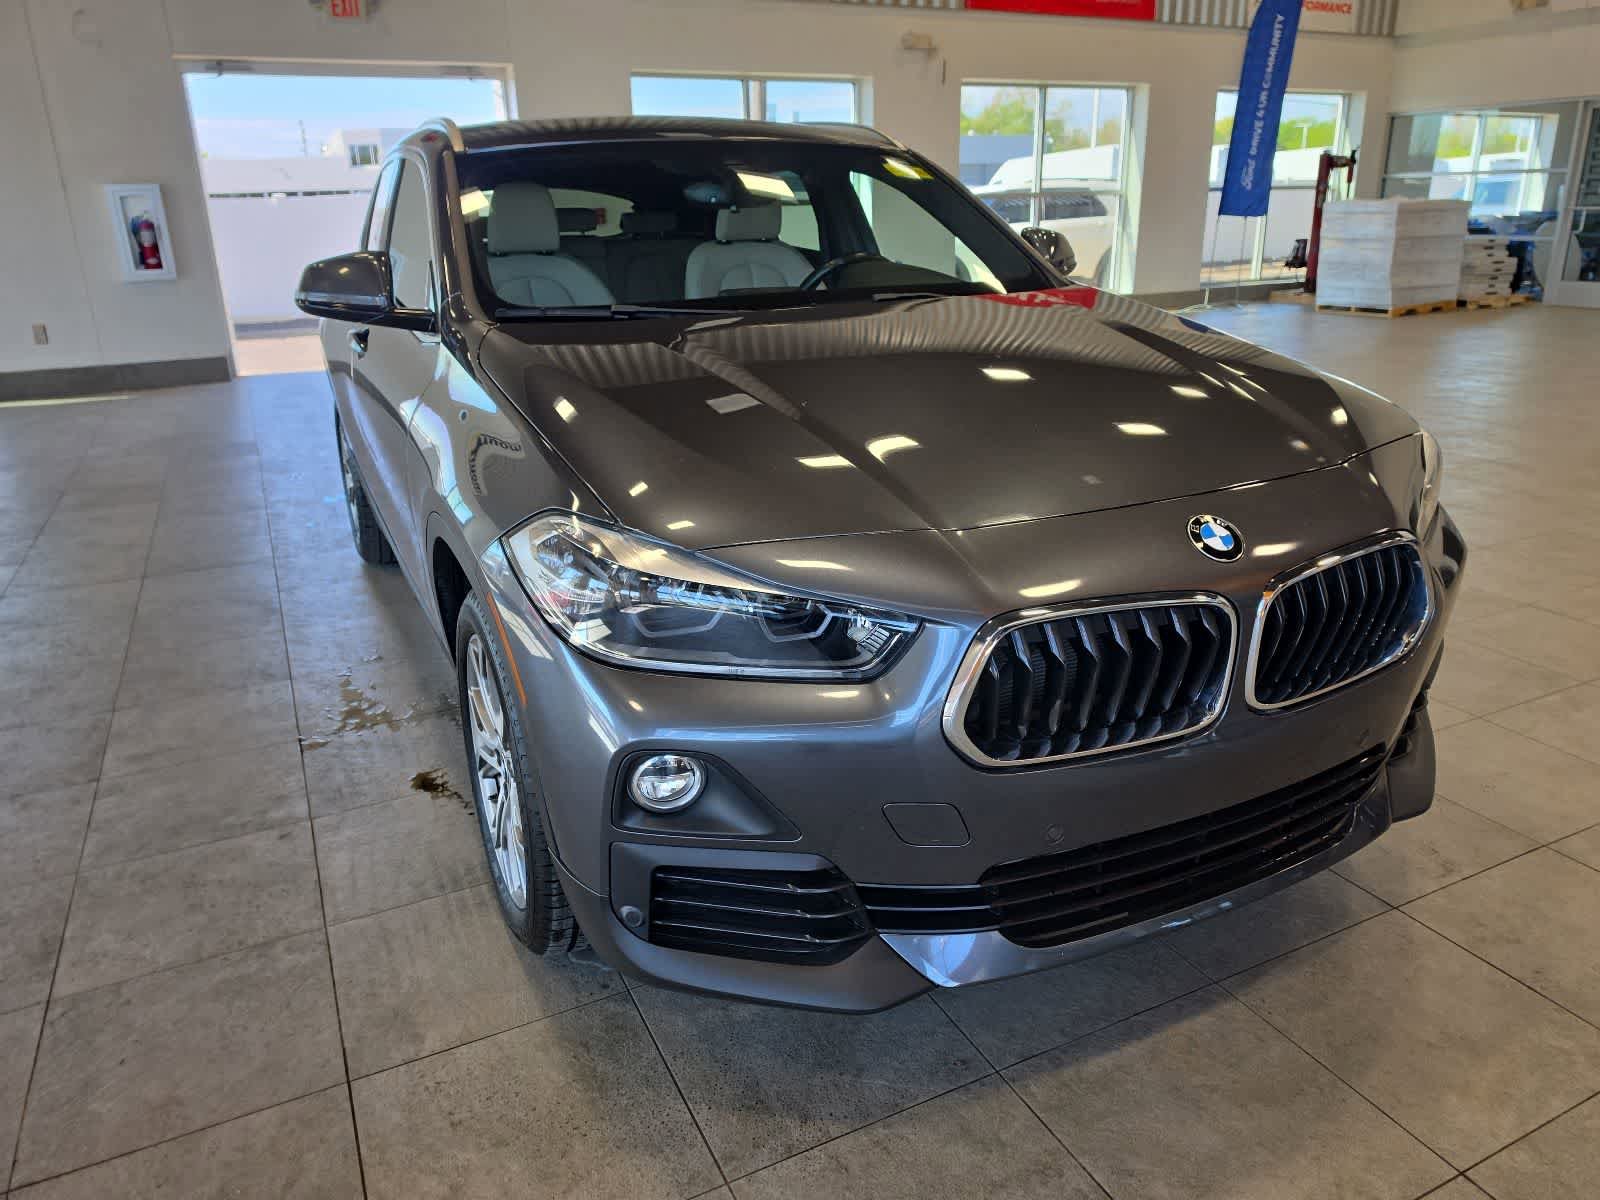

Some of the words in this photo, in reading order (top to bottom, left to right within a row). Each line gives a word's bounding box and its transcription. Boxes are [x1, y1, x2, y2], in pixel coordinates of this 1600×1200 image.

[1302, 0, 1352, 14] ORMANCE
[1240, 158, 1256, 190] Ford
[1249, 119, 1265, 156] DRIVE
[1261, 13, 1285, 89] COMMUNITY
